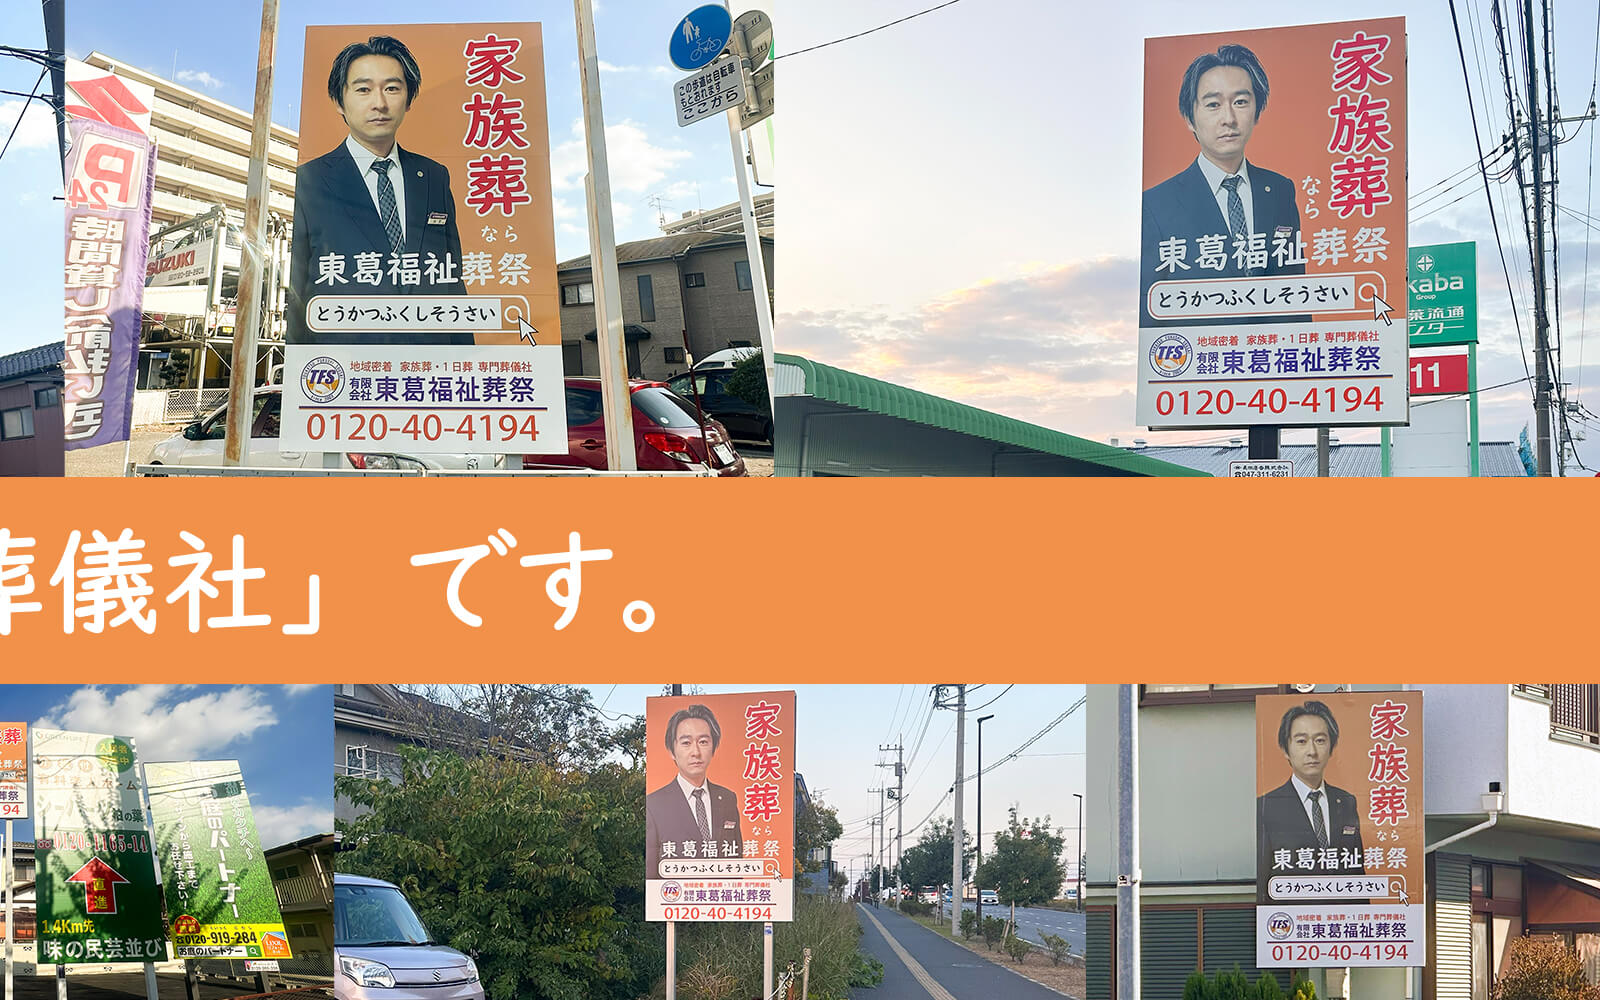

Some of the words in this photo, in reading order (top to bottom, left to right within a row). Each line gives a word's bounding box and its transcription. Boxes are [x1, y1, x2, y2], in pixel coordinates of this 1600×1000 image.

[679, 62, 736, 96] この歩道は自転車
[684, 89, 738, 120] ここから
[465, 34, 530, 217] 家族葬
[1329, 32, 1391, 218] 家族葬
[1302, 176, 1320, 219] なら
[482, 225, 517, 242] なら
[1154, 225, 1390, 274] 東葛福祉葬祭
[146, 250, 195, 276] SUZUKI
[315, 252, 532, 287] 東葛福祉葬祭
[1158, 281, 1348, 307] とうかつふくしそうさい
[317, 304, 497, 323] とうかつふくしそうさい
[1197, 335, 1239, 347] 地域密着
[1324, 330, 1379, 343] 専門葬儀社
[1158, 344, 1184, 360] TFS
[1197, 352, 1219, 363] 有限
[1221, 345, 1381, 374] 東葛福祉葬祭
[350, 361, 392, 372] 地域密着
[478, 361, 532, 372] 専門葬儀社
[1197, 363, 1219, 375] 会社
[309, 369, 336, 384] TFS
[349, 377, 372, 389] 有限
[349, 389, 372, 401] 会社
[374, 376, 535, 402] 東葛福祉葬祭
[1156, 386, 1384, 416] 0120-40-4194
[307, 413, 540, 441] 0120-40-4194
[743, 701, 782, 821] 家族葬
[1369, 700, 1409, 825] 家族葬
[751, 825, 773, 836] なら
[1376, 830, 1400, 842] なら
[661, 839, 780, 858] 東葛福祉葬祭
[1272, 847, 1408, 871] 東葛福祉葬祭
[664, 864, 761, 873] とうかつふくしそうさい
[92, 878, 108, 909] 直進
[695, 889, 772, 902] 東葛福祉葬祭
[1275, 881, 1386, 893] とうかつふくしそうさい
[664, 907, 773, 920] 0120-40-4194
[42, 920, 95, 934] 1.4Km先
[1271, 919, 1289, 929] TFS
[1311, 922, 1407, 939] 東葛福祉葬祭
[184, 931, 258, 944] 0120-919-284
[43, 938, 163, 961] 味の民芸並び
[1272, 944, 1408, 961] 0120-40-4194
